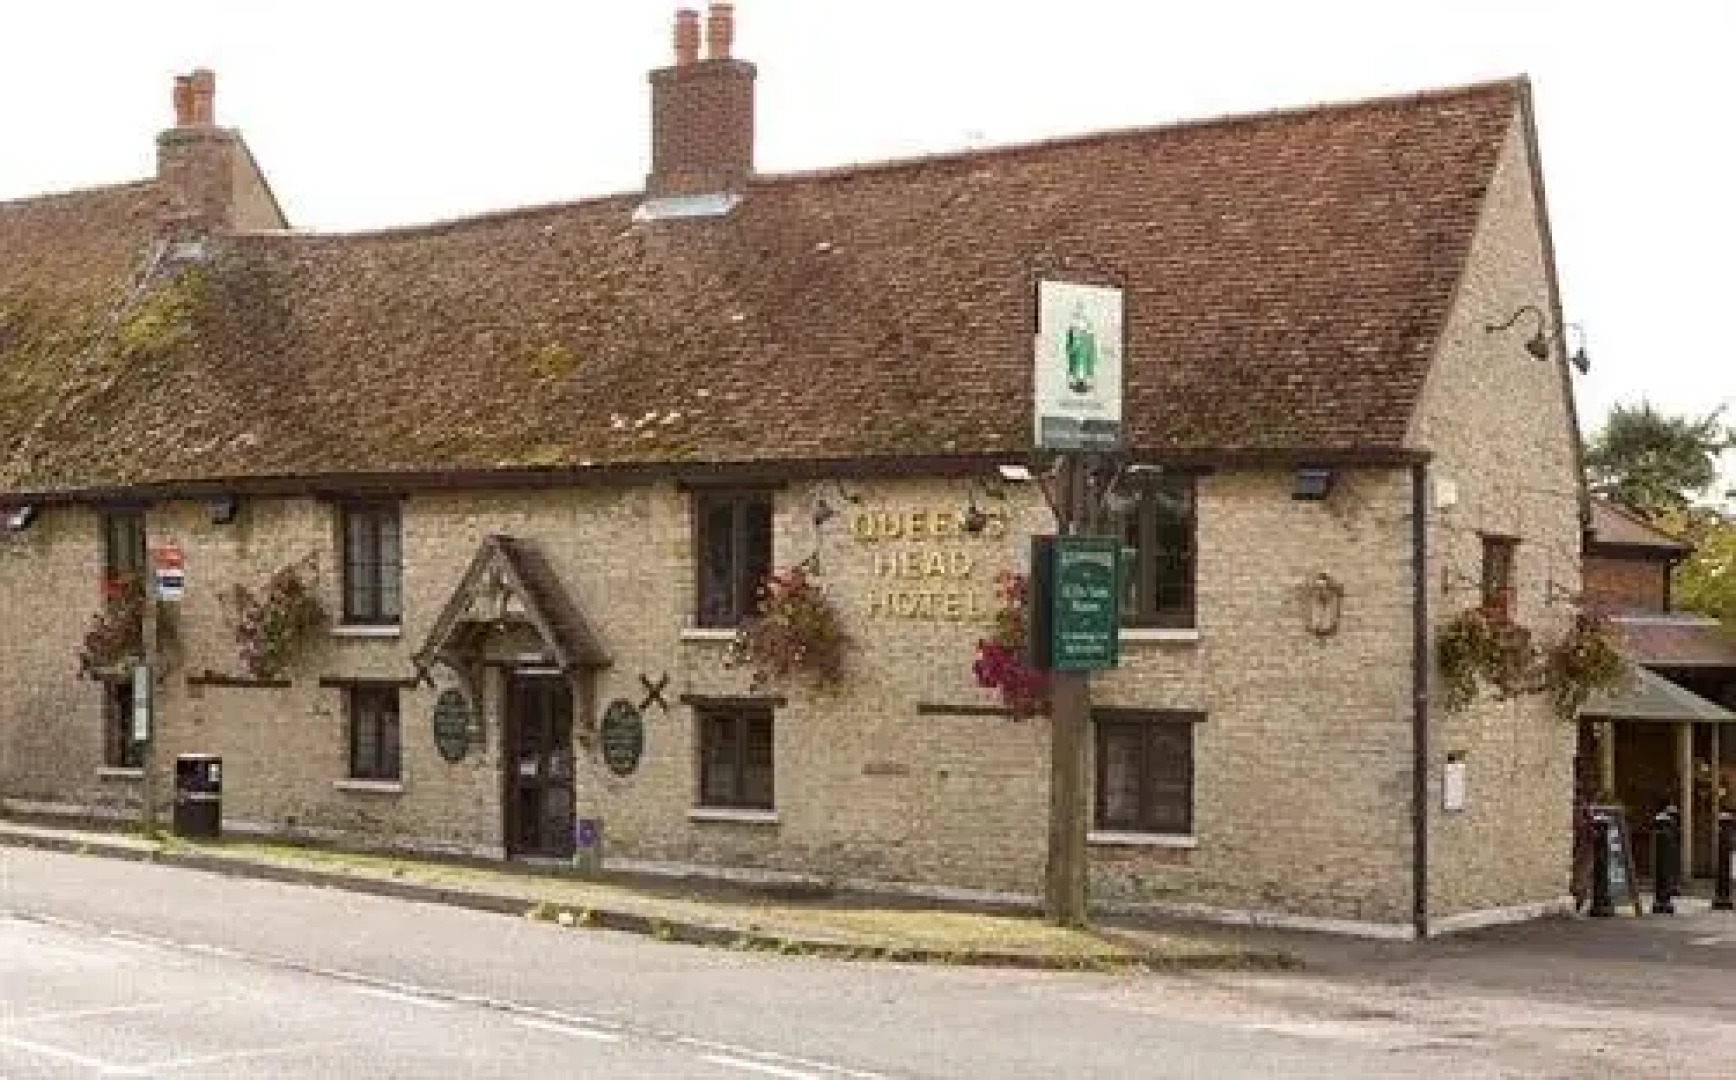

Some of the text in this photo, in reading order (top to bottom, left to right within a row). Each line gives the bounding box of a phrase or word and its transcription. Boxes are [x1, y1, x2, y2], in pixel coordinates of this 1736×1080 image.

[851, 508, 1007, 536] QUEES
[872, 551, 975, 577] HEAD
[867, 590, 985, 619] HOTEL
